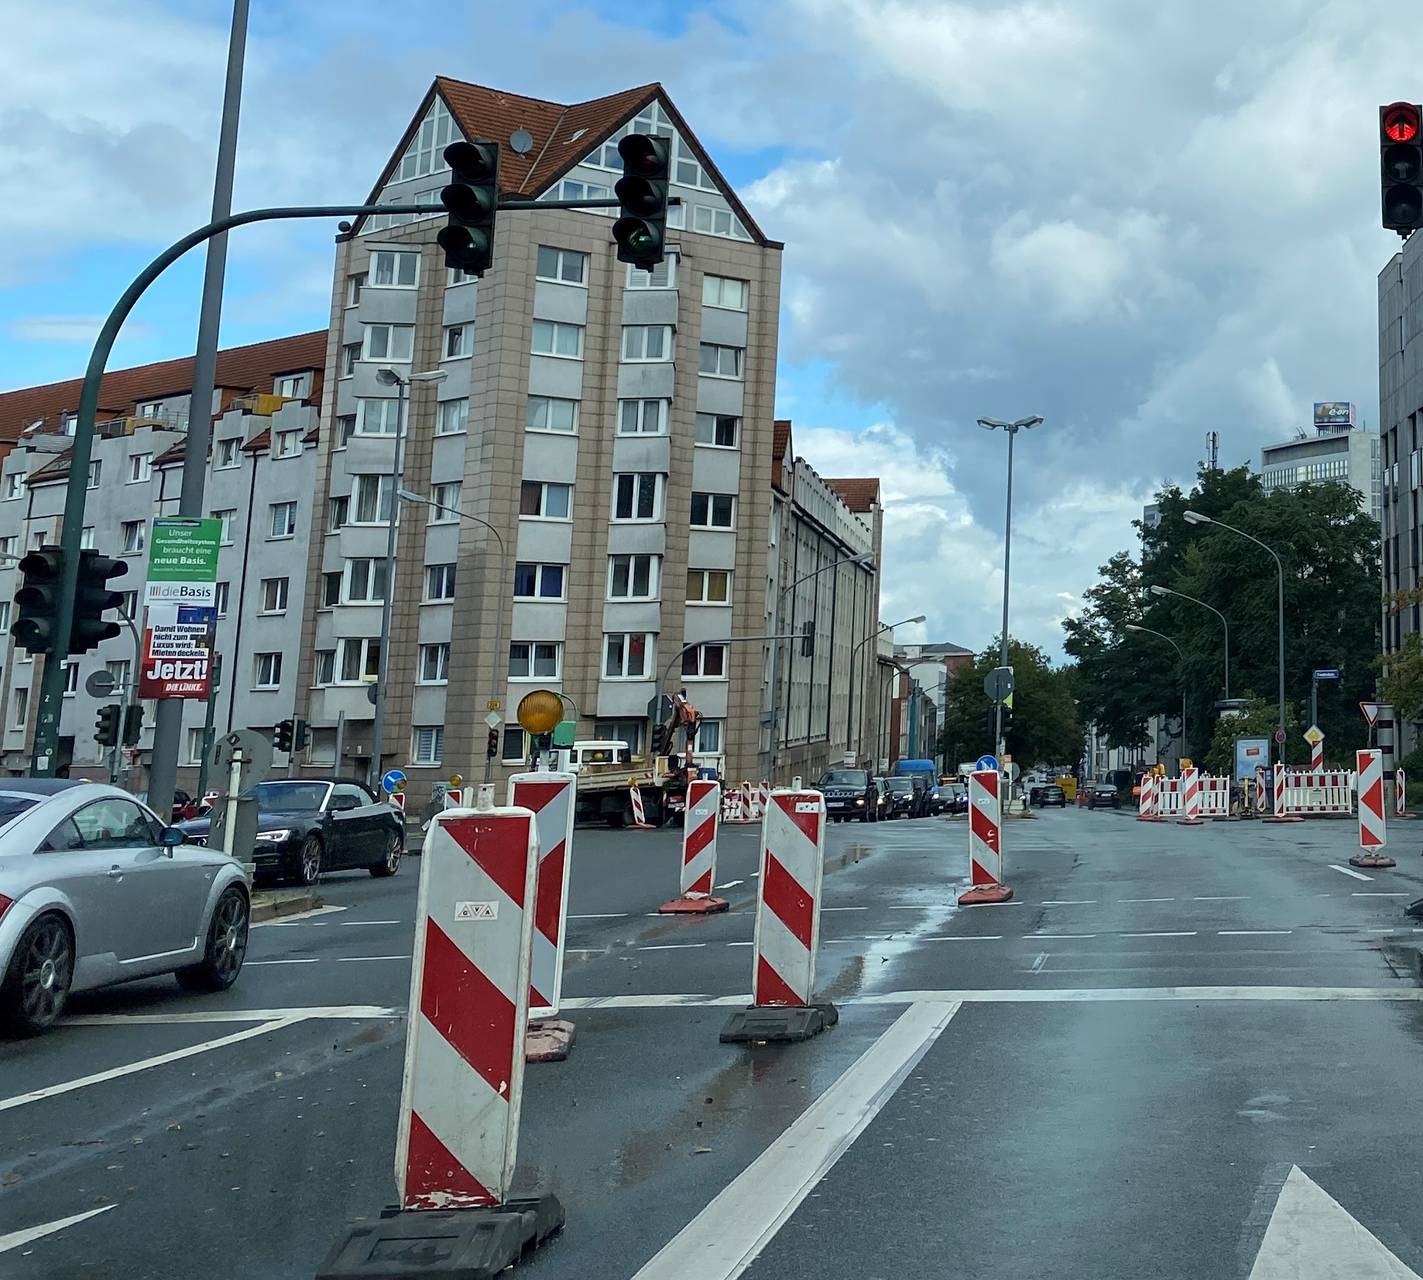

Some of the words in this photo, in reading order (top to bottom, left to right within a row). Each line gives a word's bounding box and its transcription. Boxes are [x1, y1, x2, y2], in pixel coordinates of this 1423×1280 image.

[169, 528, 192, 537] Unser
[163, 546, 194, 554] braucht
[195, 547, 212, 555] eine
[154, 556, 178, 565] neue
[180, 556, 207, 565] Basis.
[154, 625, 176, 633] Damit
[177, 624, 205, 633] Wohnen
[152, 641, 174, 649] Luxus
[177, 649, 206, 657] deckeln.
[146, 660, 207, 679] Jetzt!
[165, 683, 179, 692] DIE
